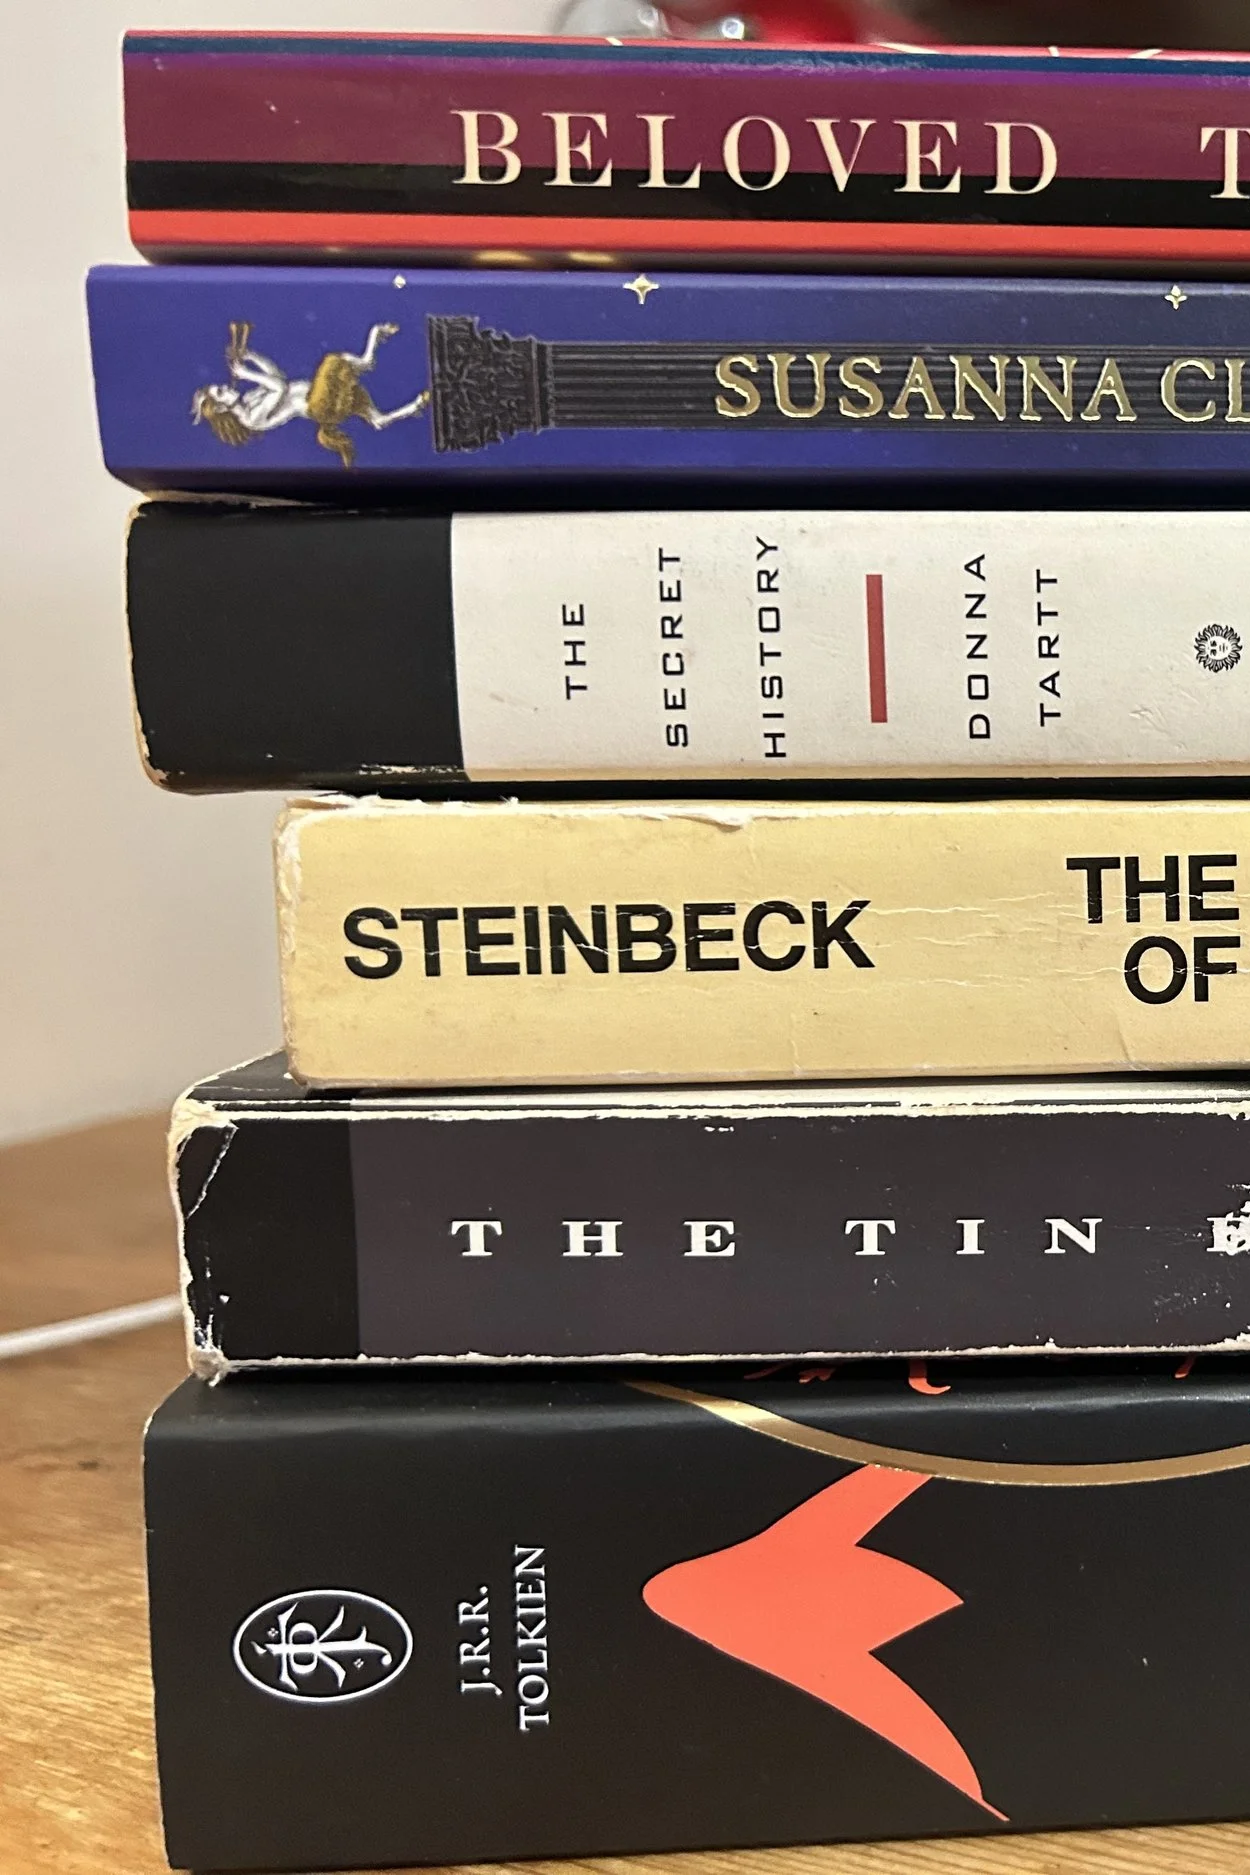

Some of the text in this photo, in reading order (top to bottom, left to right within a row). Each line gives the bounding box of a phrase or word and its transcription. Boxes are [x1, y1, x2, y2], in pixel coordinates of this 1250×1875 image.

[450, 108, 1059, 195] BELOVED
[713, 351, 1138, 423] SUSANNA
[562, 601, 587, 701] THE
[658, 547, 690, 748] SECRET
[756, 535, 787, 759] HISTORY
[963, 552, 992, 740] DONNA
[1036, 568, 1060, 727] TARTT
[343, 899, 876, 980] STEINBECK
[1066, 854, 1241, 925] THE
[1123, 934, 1242, 1005] OF
[451, 1218, 737, 1258] THE
[843, 1216, 1104, 1256] TIN
[459, 1585, 502, 1696] J.R.R.
[514, 1545, 550, 1732] TOLKIEN
